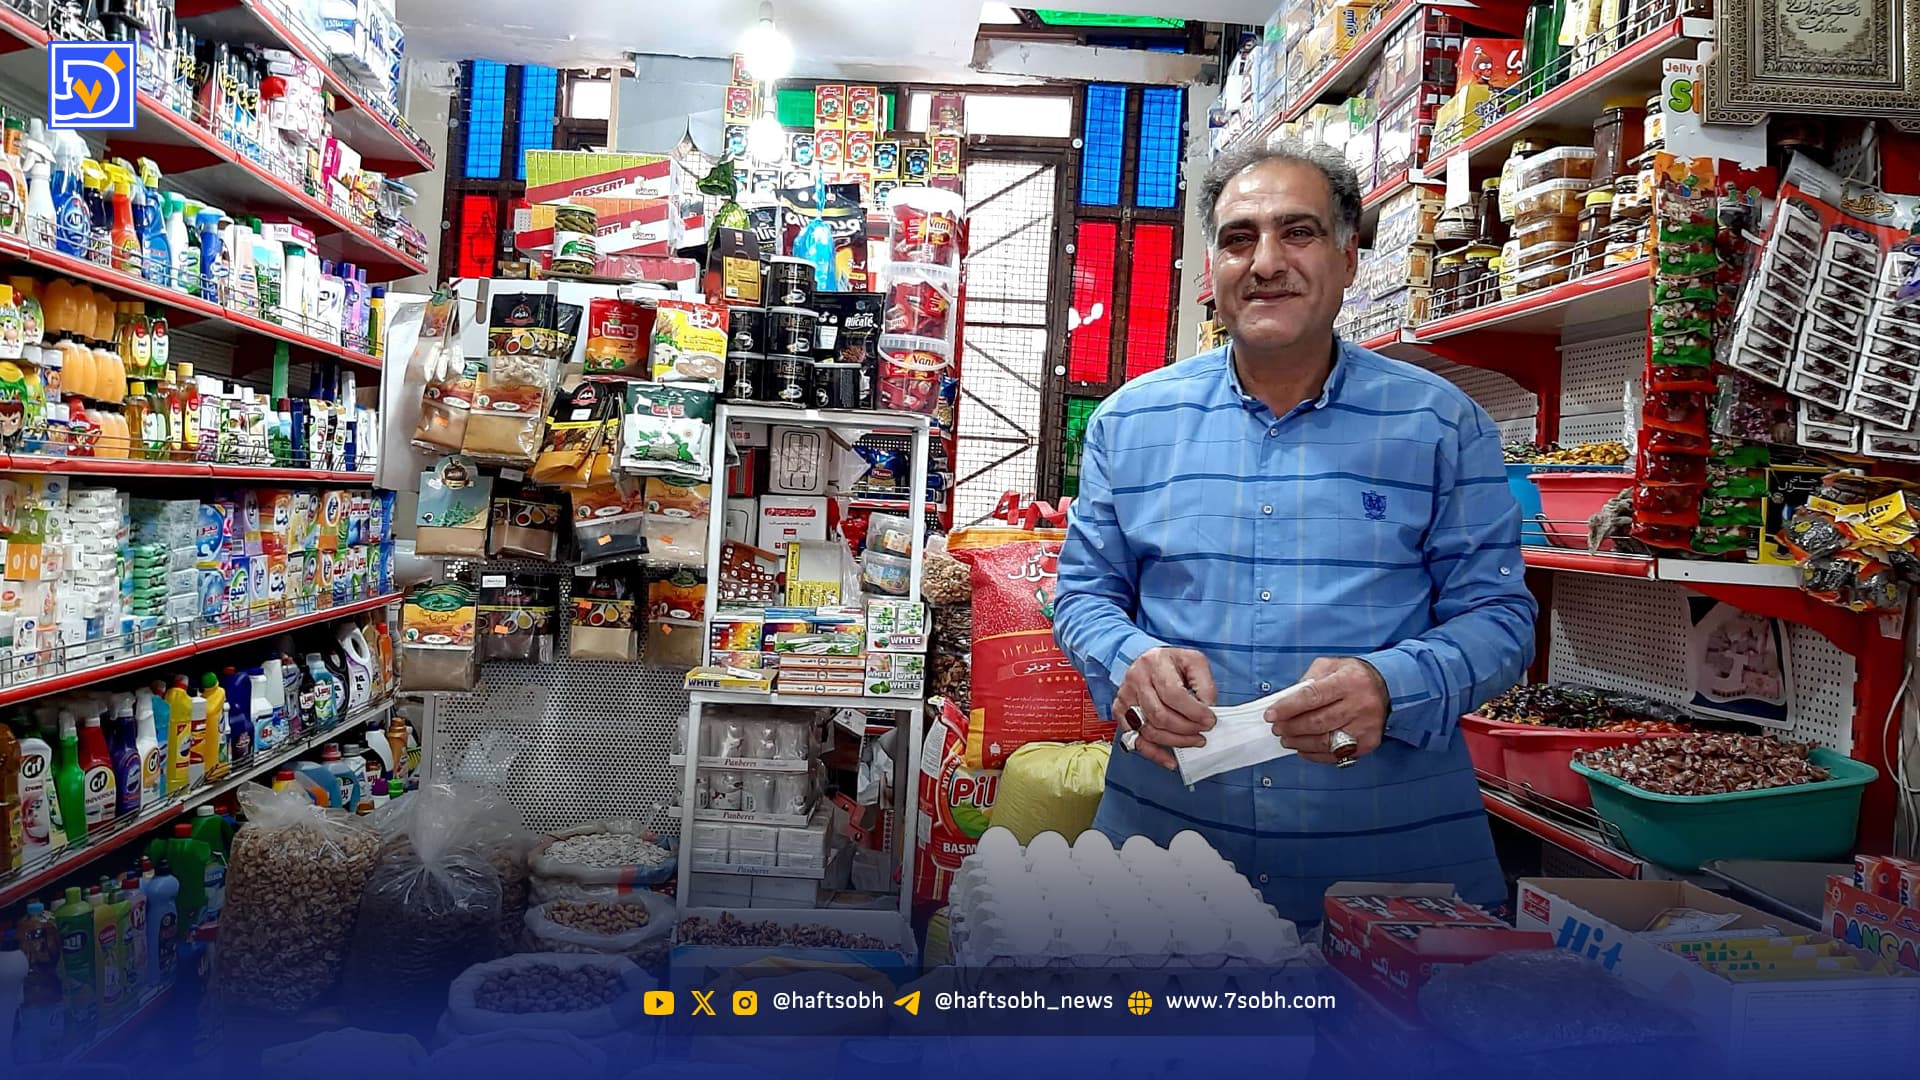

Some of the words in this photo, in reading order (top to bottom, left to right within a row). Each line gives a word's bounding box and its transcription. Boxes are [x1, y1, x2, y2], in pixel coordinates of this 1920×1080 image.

[1665, 62, 1693, 76] Jelly
[889, 635, 921, 646] WHITE
[866, 670, 892, 679] WHITE
[688, 679, 720, 688] WHITE
[889, 680, 920, 690] WHITE
[23, 755, 44, 778] Cif
[90, 771, 107, 792] Cif
[1557, 915, 1623, 971] Hit
